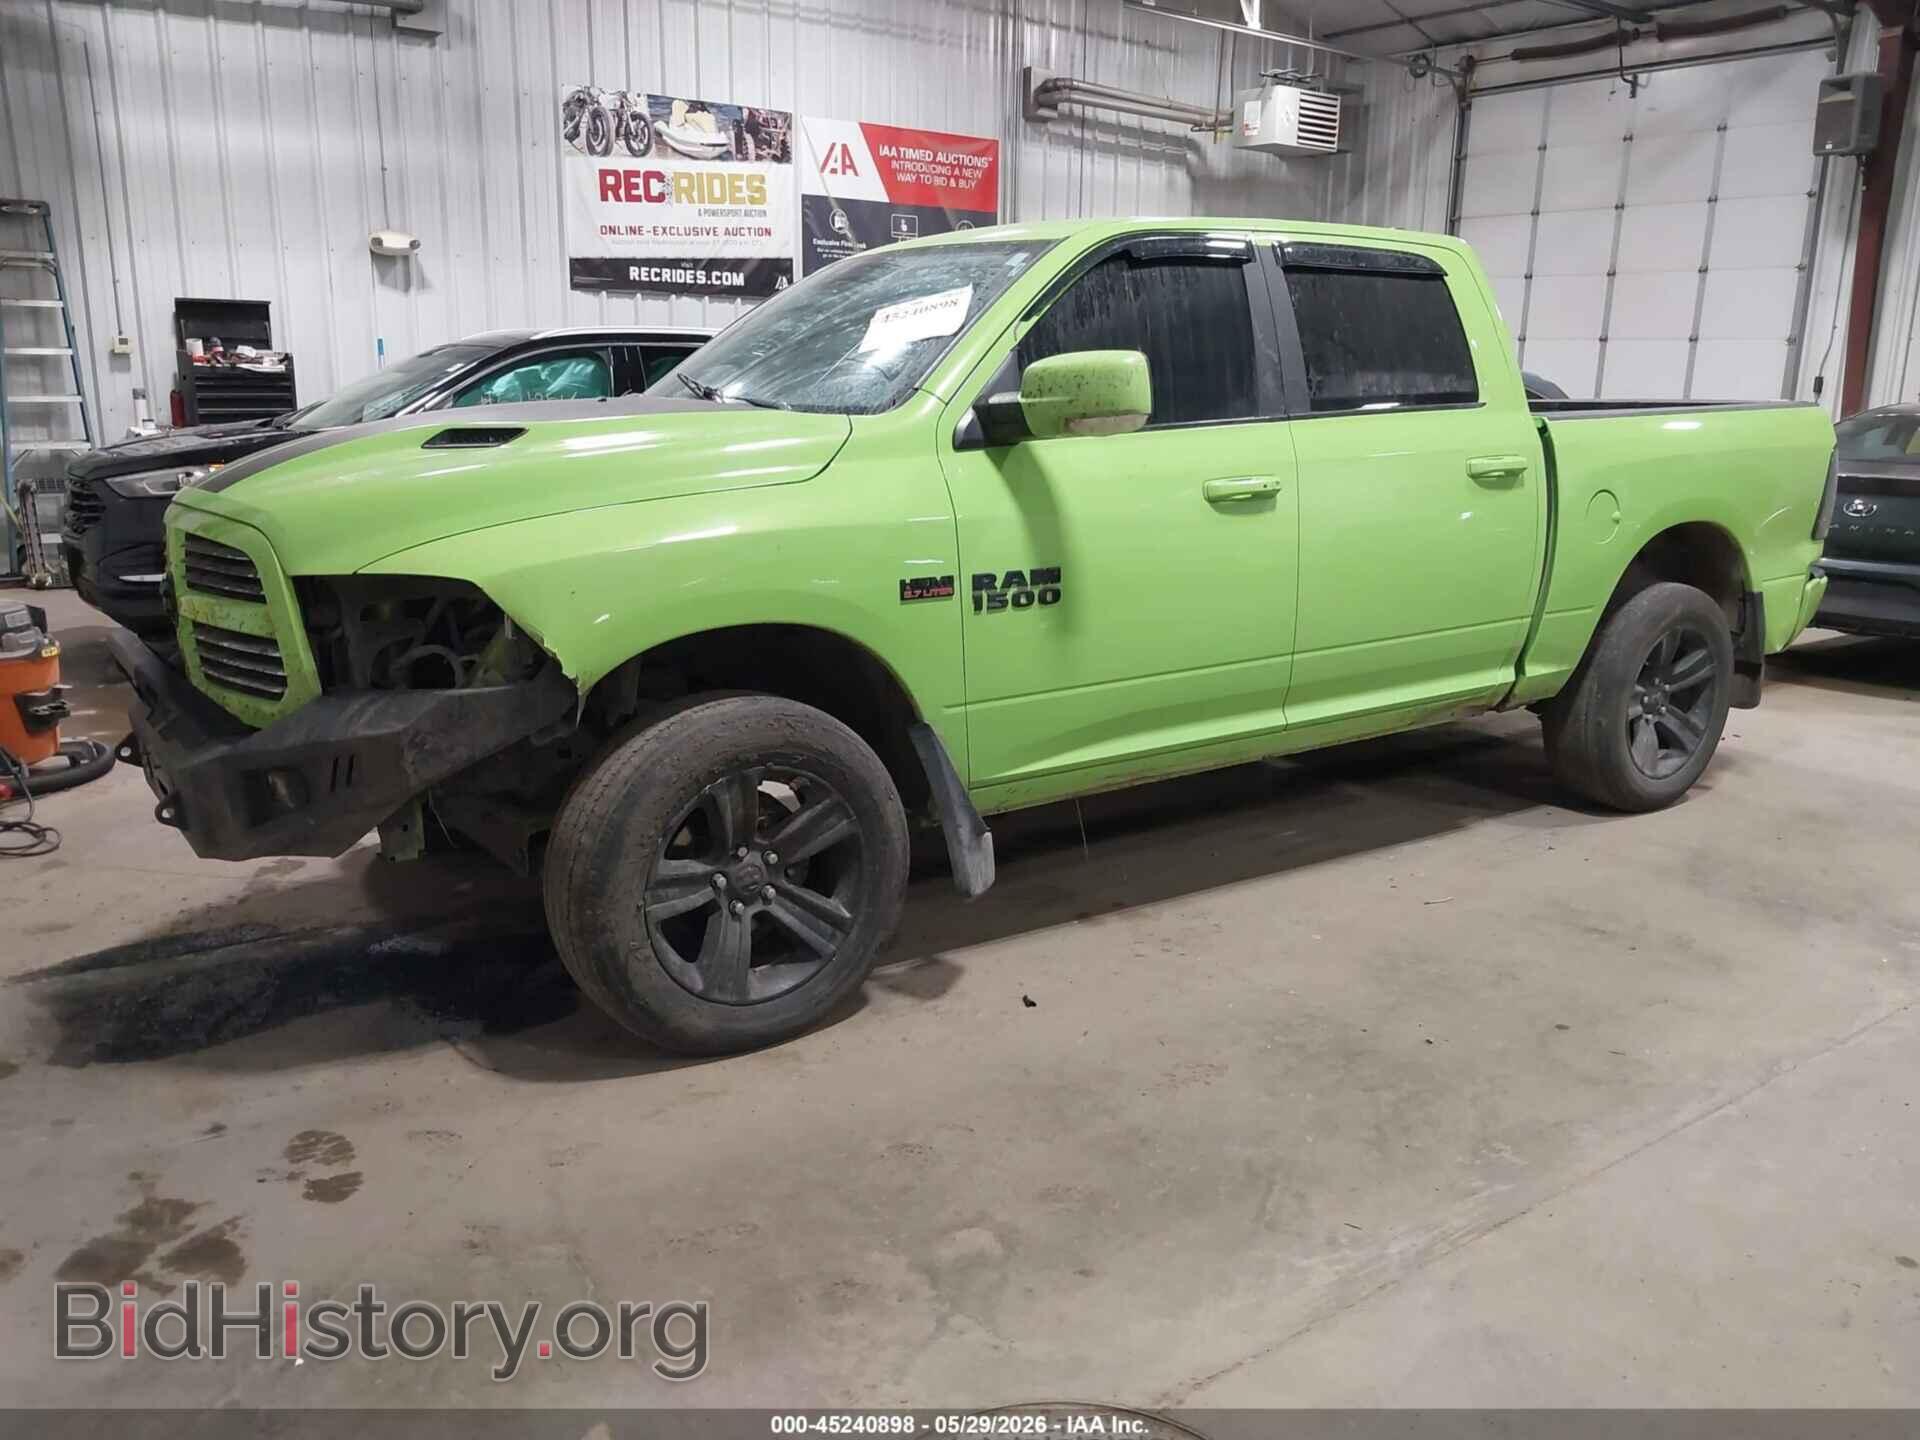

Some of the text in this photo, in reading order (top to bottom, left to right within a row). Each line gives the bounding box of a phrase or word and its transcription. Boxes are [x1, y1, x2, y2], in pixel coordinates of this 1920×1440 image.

[879, 144, 897, 157] IAA
[899, 147, 933, 161] TIMED
[891, 160, 983, 179] INTRODUCING A NEW
[599, 169, 767, 205] REC RIDES
[896, 172, 977, 189] WAY TO BID & BUY
[600, 225, 772, 237] ONLINE-EXCLUSIVE AUCTION
[629, 266, 745, 286] RECRIDES.COM
[972, 567, 1061, 592] RAM
[973, 588, 1061, 612] 1500
